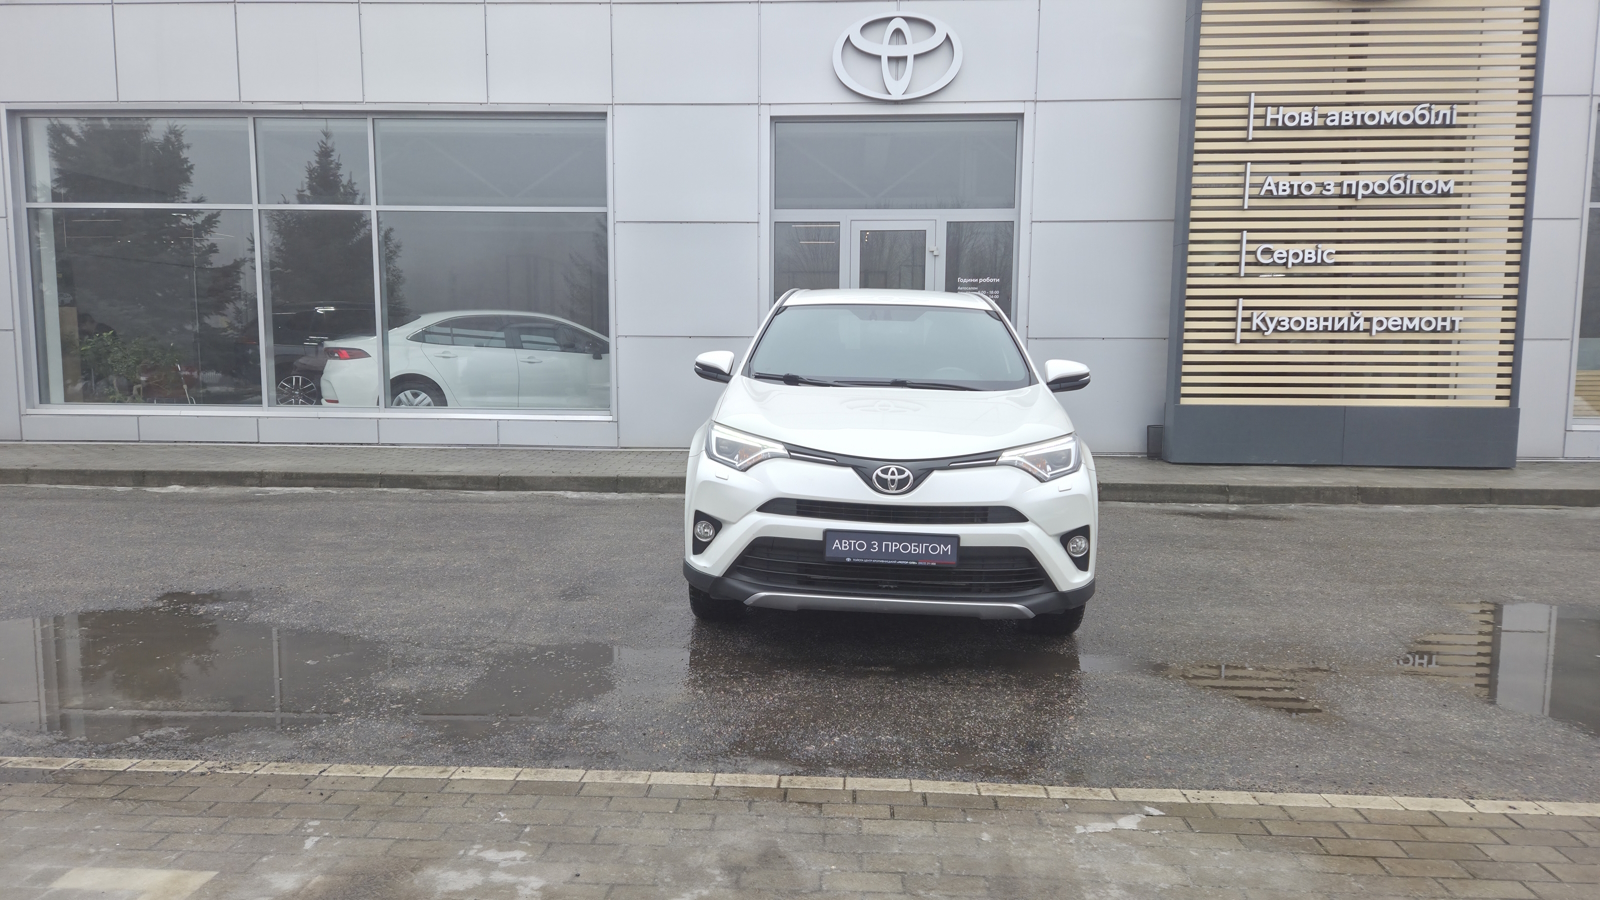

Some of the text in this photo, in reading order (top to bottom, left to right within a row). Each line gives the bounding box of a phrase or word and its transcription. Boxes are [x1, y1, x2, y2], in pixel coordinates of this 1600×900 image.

[1265, 103, 1458, 127] Нові автомобілі
[1260, 173, 1455, 200] Авто з пробігом
[1256, 243, 1336, 269] Сервіс
[1251, 311, 1464, 337] Кузовний ремонт
[832, 539, 951, 555] АВТО З ПРОБІГОМ
